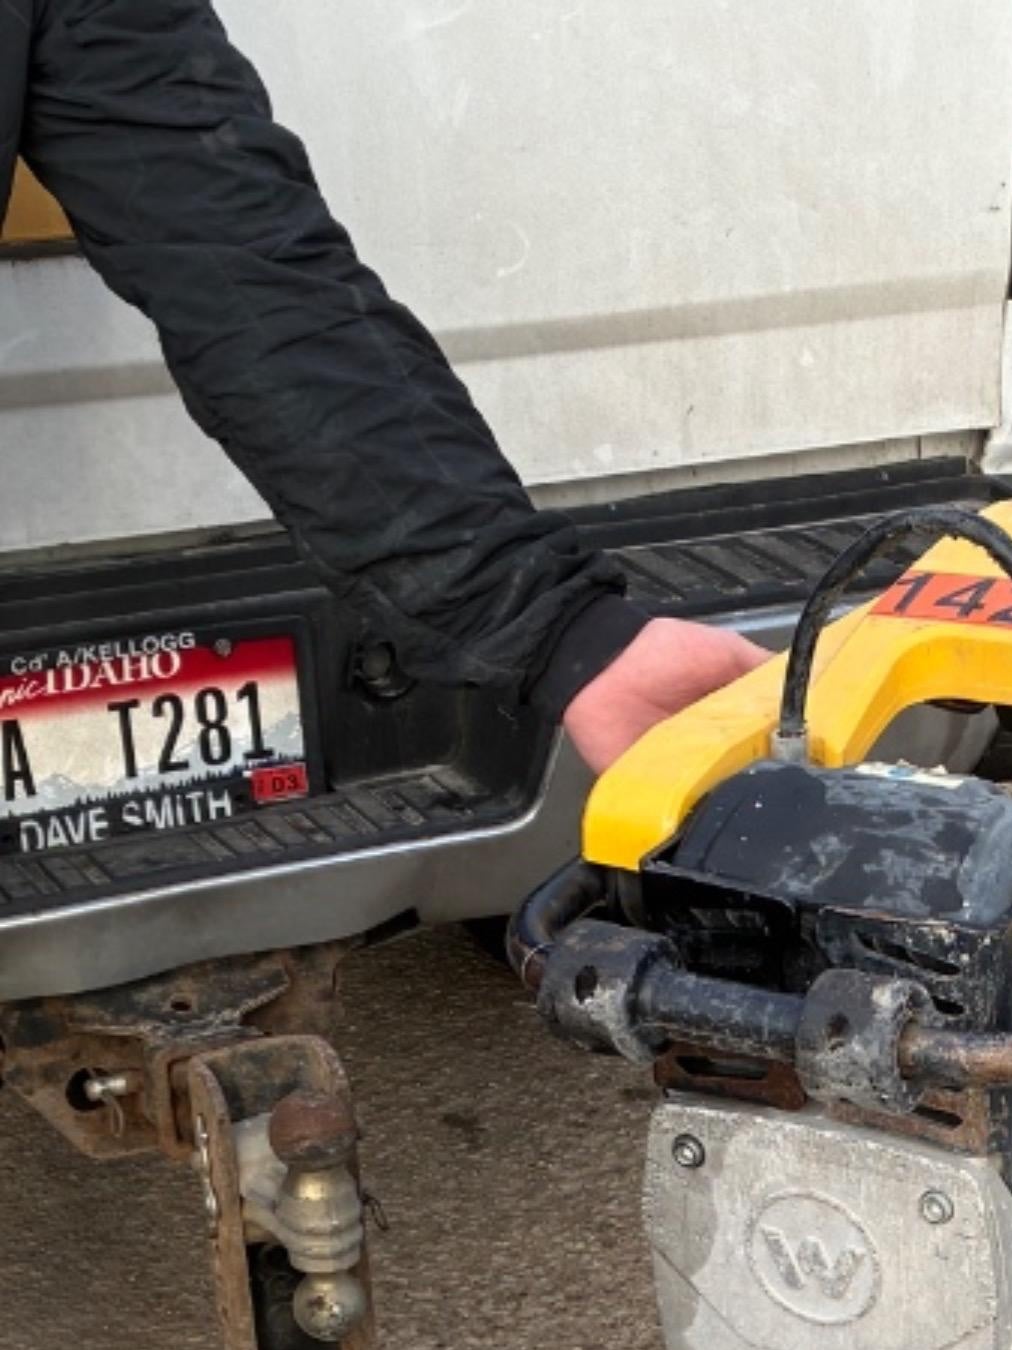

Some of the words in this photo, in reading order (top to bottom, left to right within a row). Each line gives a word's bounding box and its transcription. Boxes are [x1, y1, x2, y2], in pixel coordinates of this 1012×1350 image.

[46, 650, 181, 694] IDAHO
[107, 681, 274, 777] T281
[272, 775, 298, 792] 03
[20, 807, 109, 852] DAVE
[122, 789, 232, 830] SMITH
